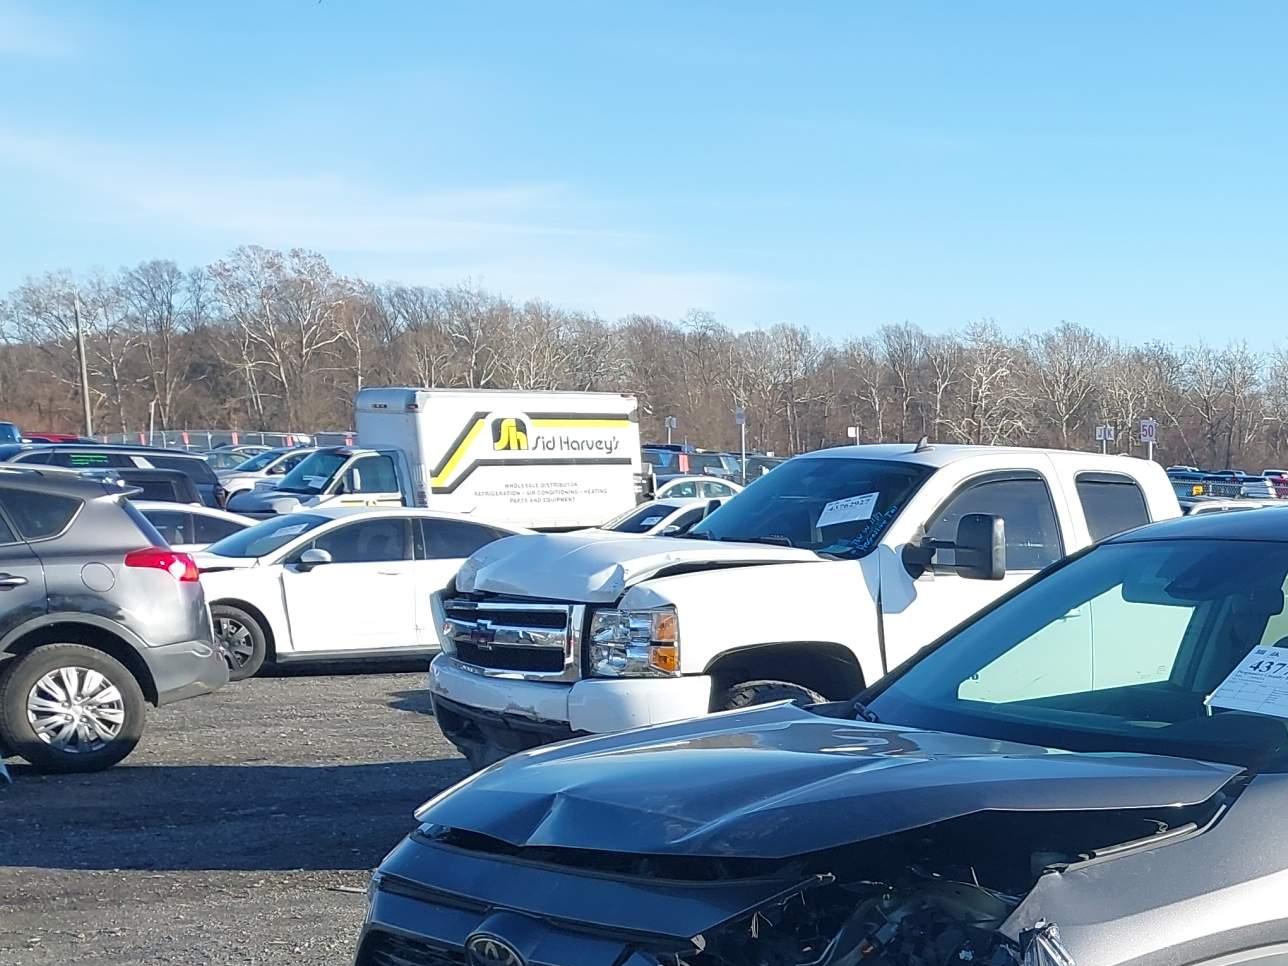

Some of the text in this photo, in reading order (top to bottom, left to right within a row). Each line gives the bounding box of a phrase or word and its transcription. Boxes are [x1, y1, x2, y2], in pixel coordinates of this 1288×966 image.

[1142, 425, 1153, 437] 50
[532, 436, 619, 454] Sid Harvey's
